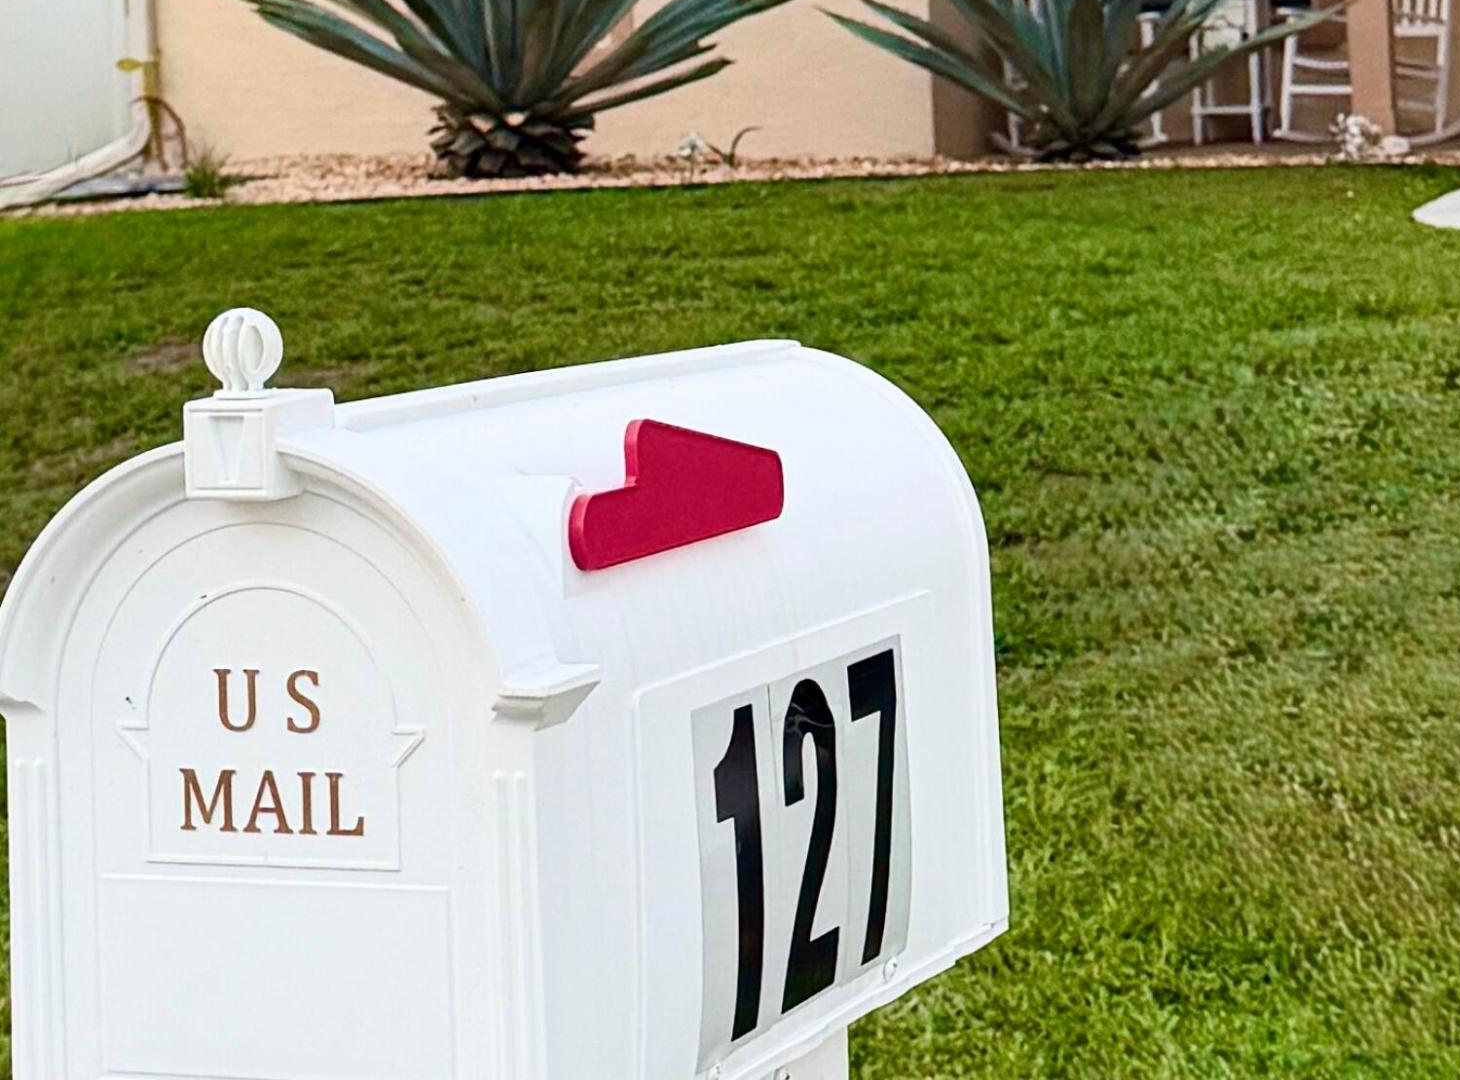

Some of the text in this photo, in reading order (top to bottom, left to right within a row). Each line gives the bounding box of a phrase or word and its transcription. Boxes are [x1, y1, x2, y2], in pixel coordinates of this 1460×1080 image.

[213, 668, 321, 734] U S
[178, 768, 365, 837] MAIL
[713, 648, 897, 1042] 127
